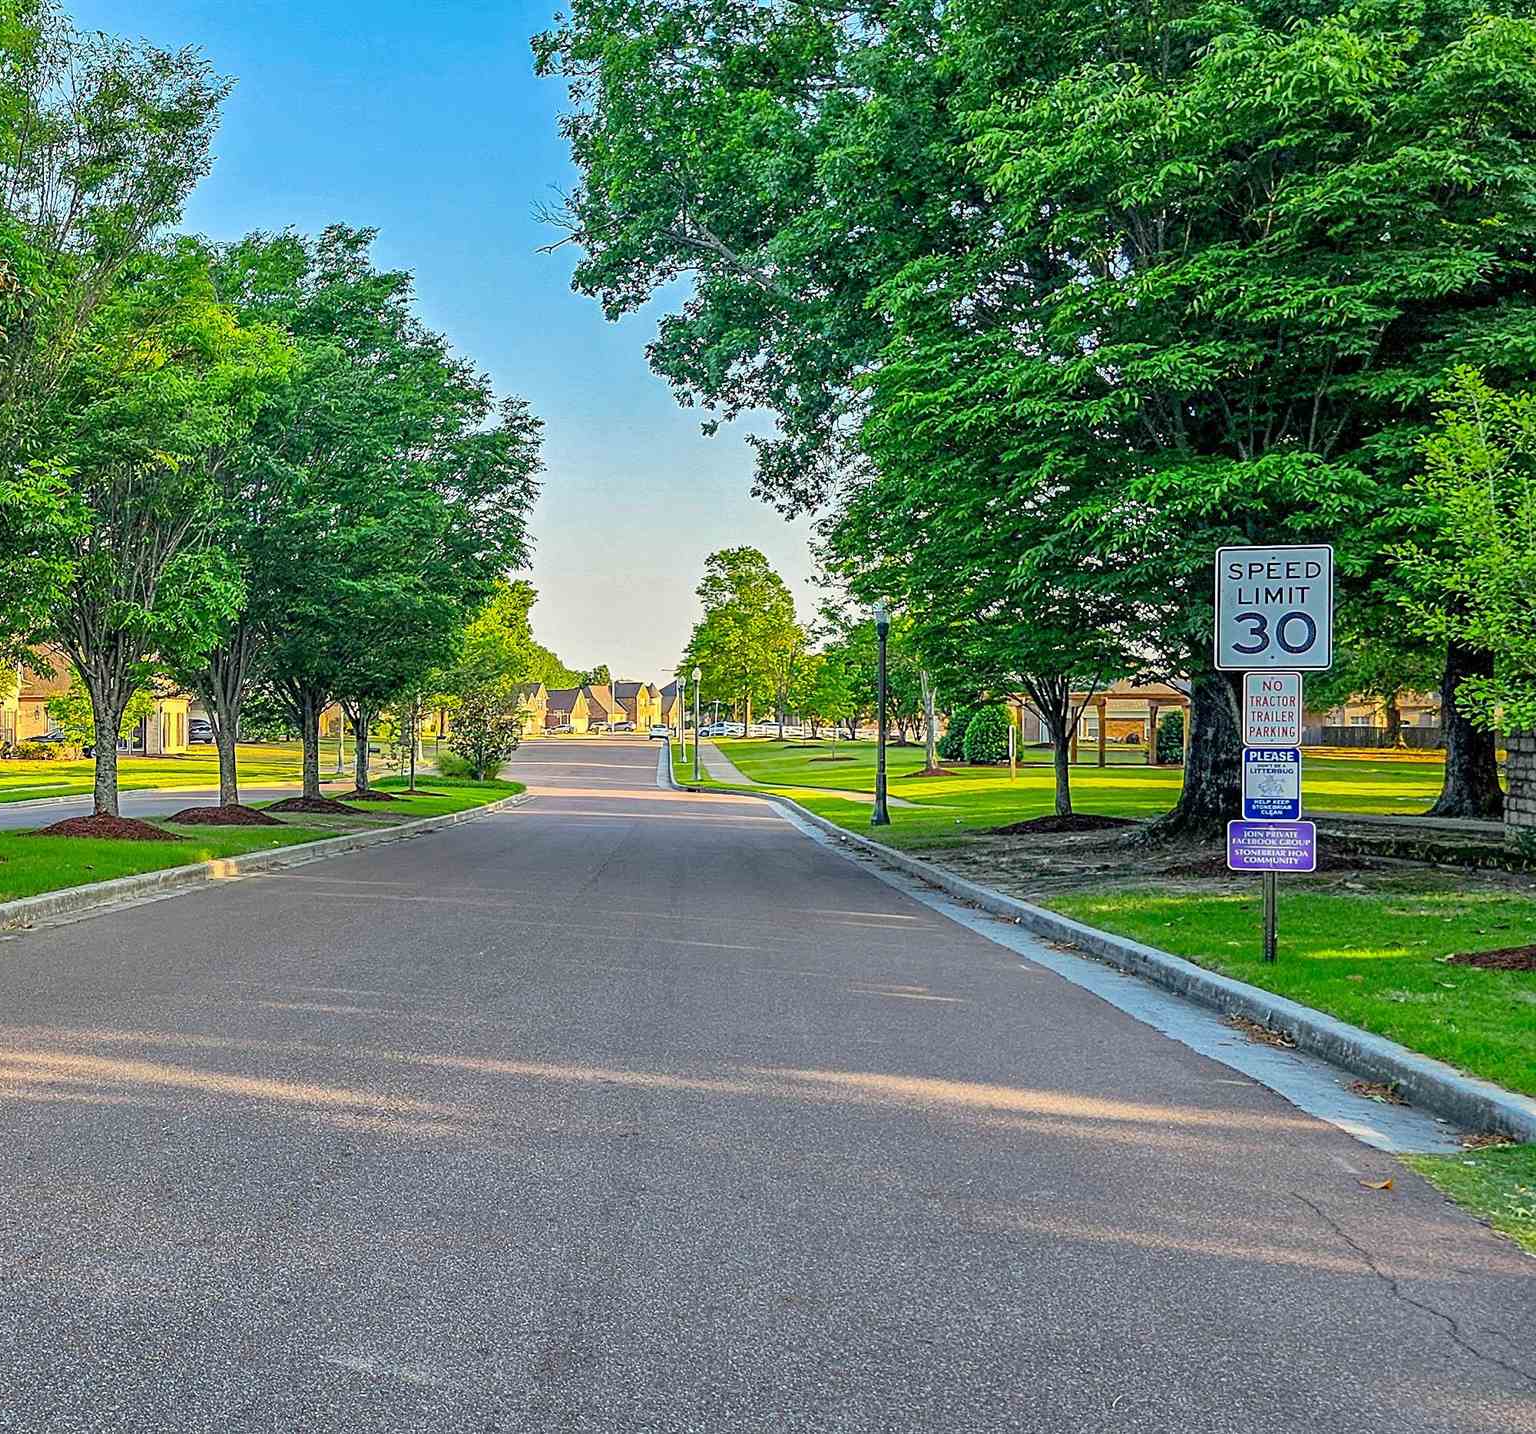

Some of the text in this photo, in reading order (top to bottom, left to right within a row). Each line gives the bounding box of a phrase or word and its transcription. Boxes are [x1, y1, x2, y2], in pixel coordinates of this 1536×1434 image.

[1228, 562, 1321, 580] SPEED
[1238, 587, 1310, 604] LIMIT
[1232, 611, 1317, 654] 30
[1263, 681, 1283, 691] NO
[1250, 696, 1296, 706] TRACTOR
[1252, 711, 1294, 722] TRAILER
[1249, 727, 1296, 737] PARKING
[1249, 751, 1295, 761] PLEASE
[1266, 831, 1297, 839] PRIVATE
[1280, 838, 1311, 846] GROUP
[1234, 849, 1308, 857] STONEBRIAR HOA
[1244, 856, 1298, 864] COMMUNITY
